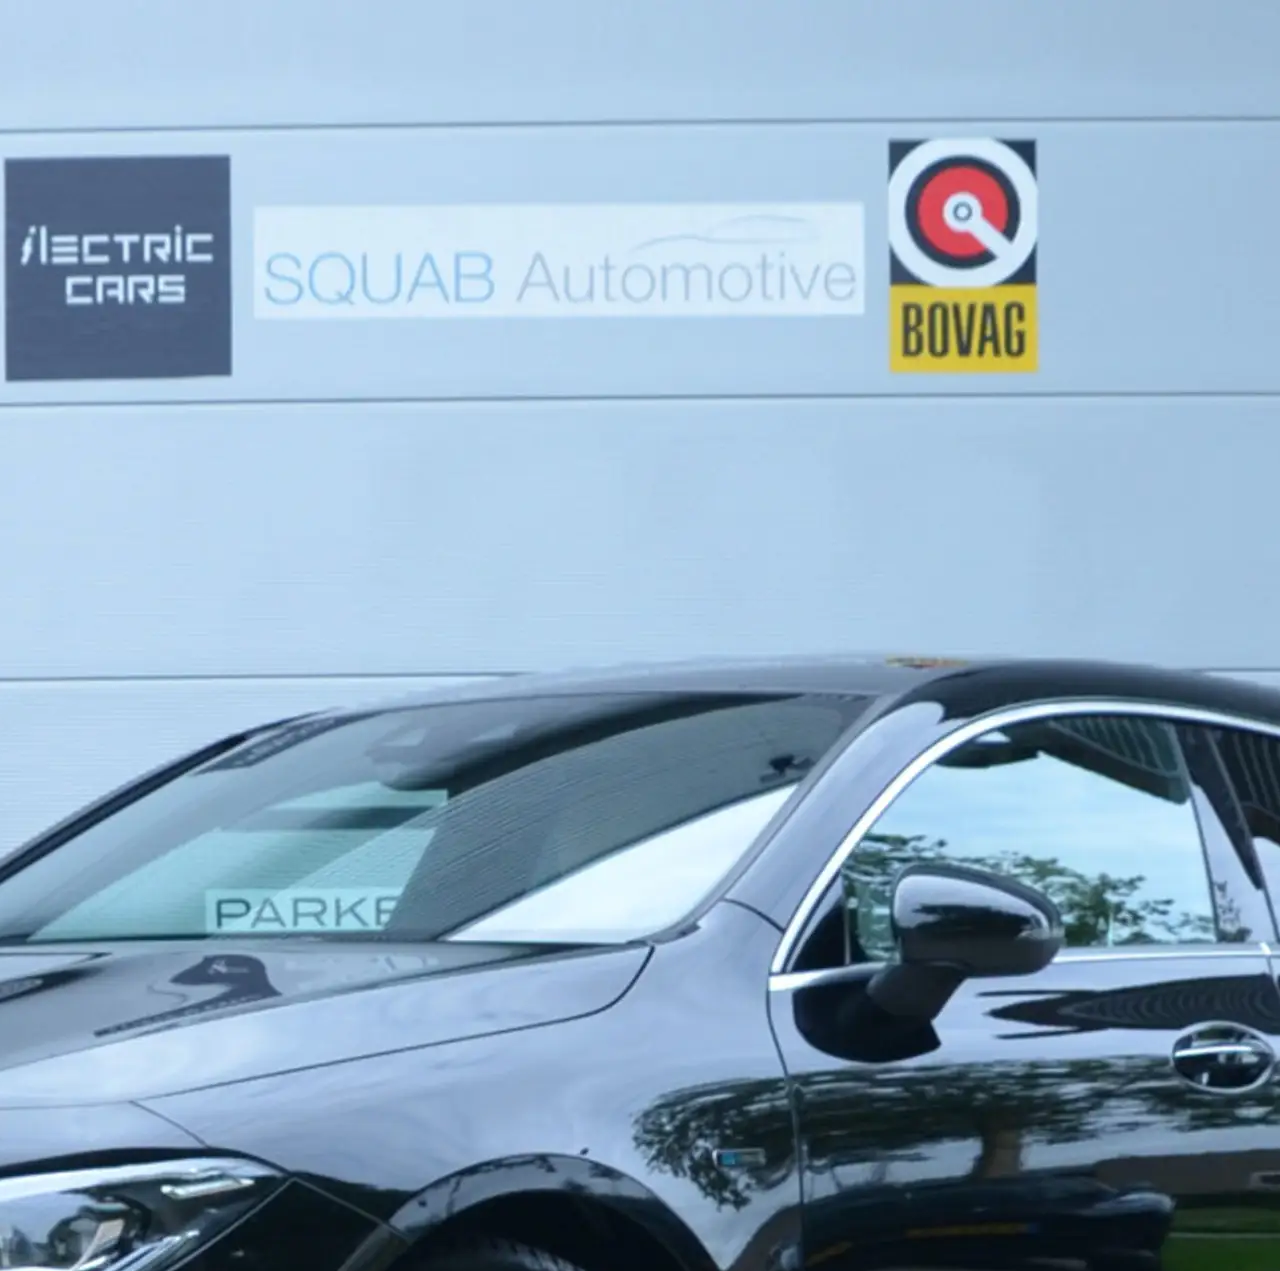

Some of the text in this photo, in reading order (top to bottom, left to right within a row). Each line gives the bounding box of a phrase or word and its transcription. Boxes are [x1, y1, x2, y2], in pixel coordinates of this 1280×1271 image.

[65, 274, 186, 305] CARS
[265, 251, 858, 306] SQUAB Automotive
[902, 301, 1026, 360] BOVAG
